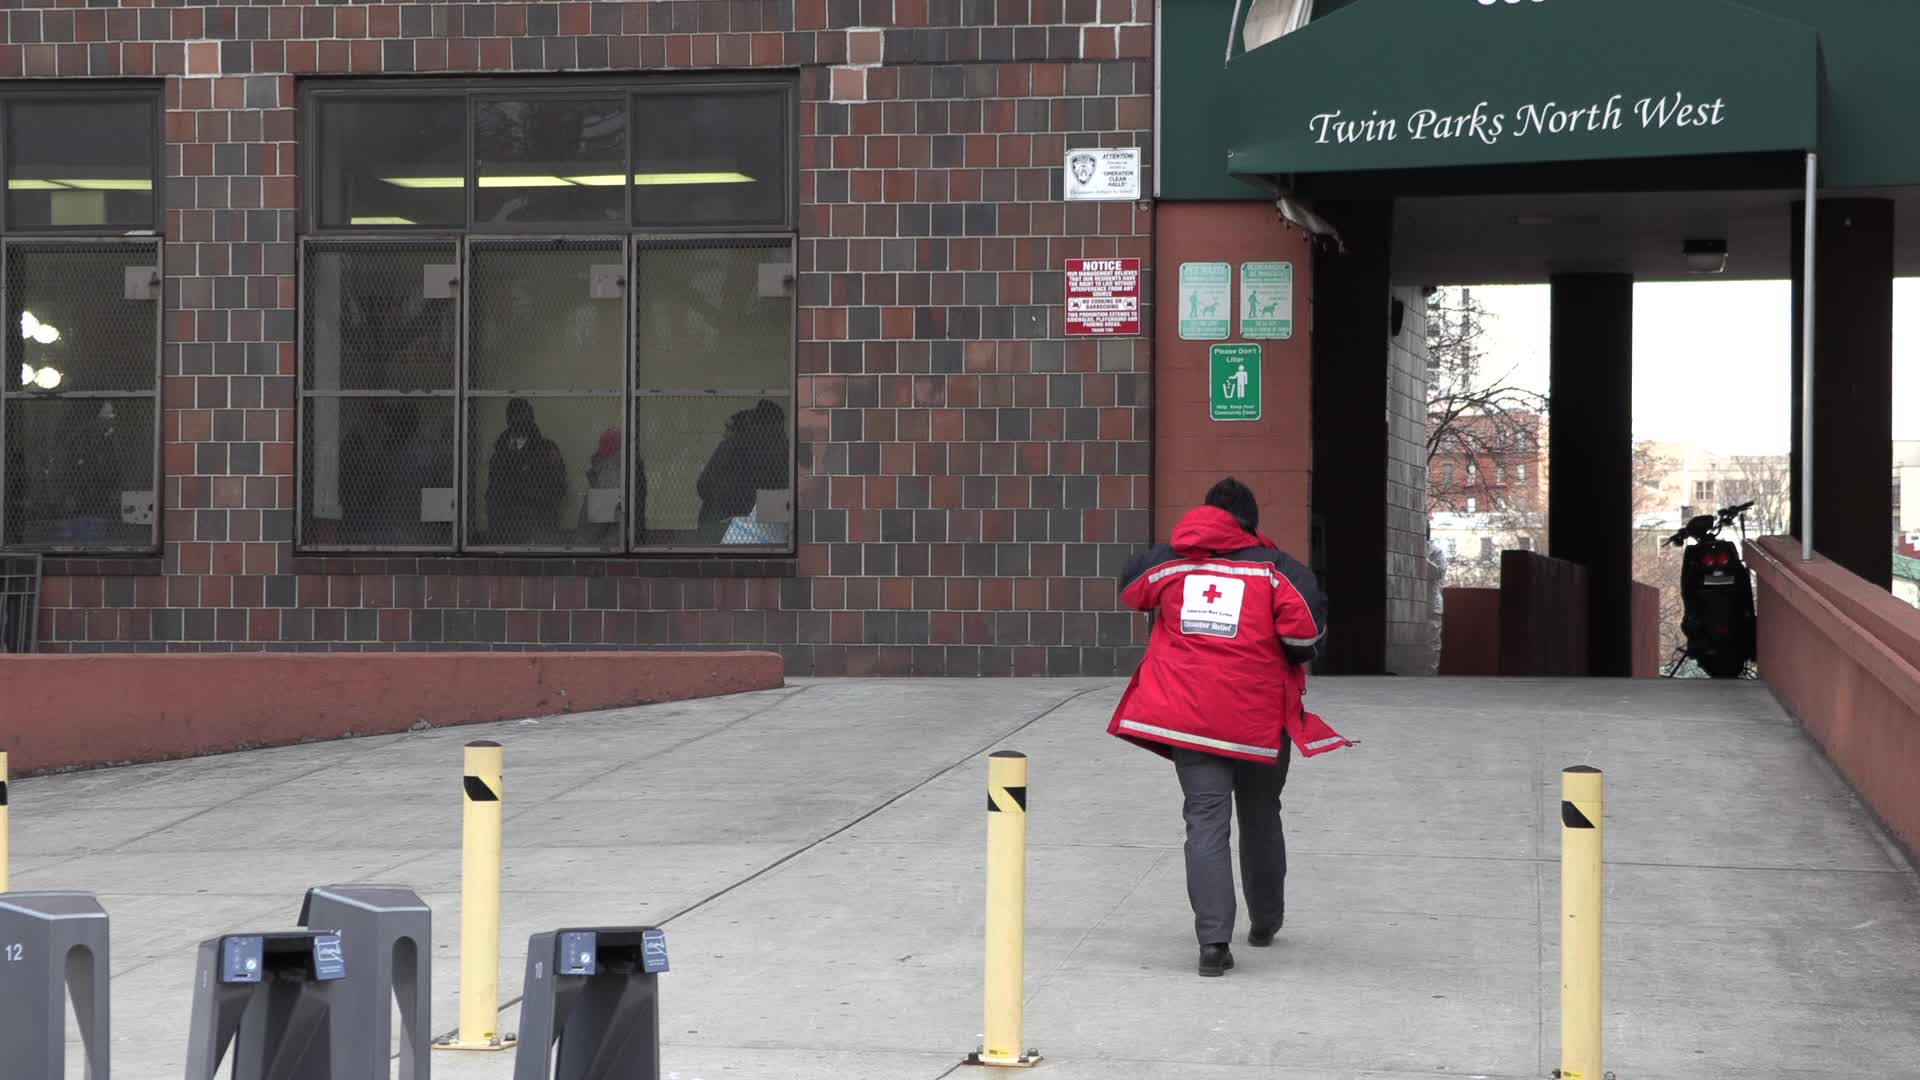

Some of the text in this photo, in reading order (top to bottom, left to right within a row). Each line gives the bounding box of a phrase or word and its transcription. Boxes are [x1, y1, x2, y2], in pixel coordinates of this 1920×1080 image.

[1309, 91, 1726, 145] Twin Parks North West
[1083, 261, 1122, 271] NOTICE
[1184, 620, 1232, 632] Disaster Relief
[5, 944, 23, 961] 12
